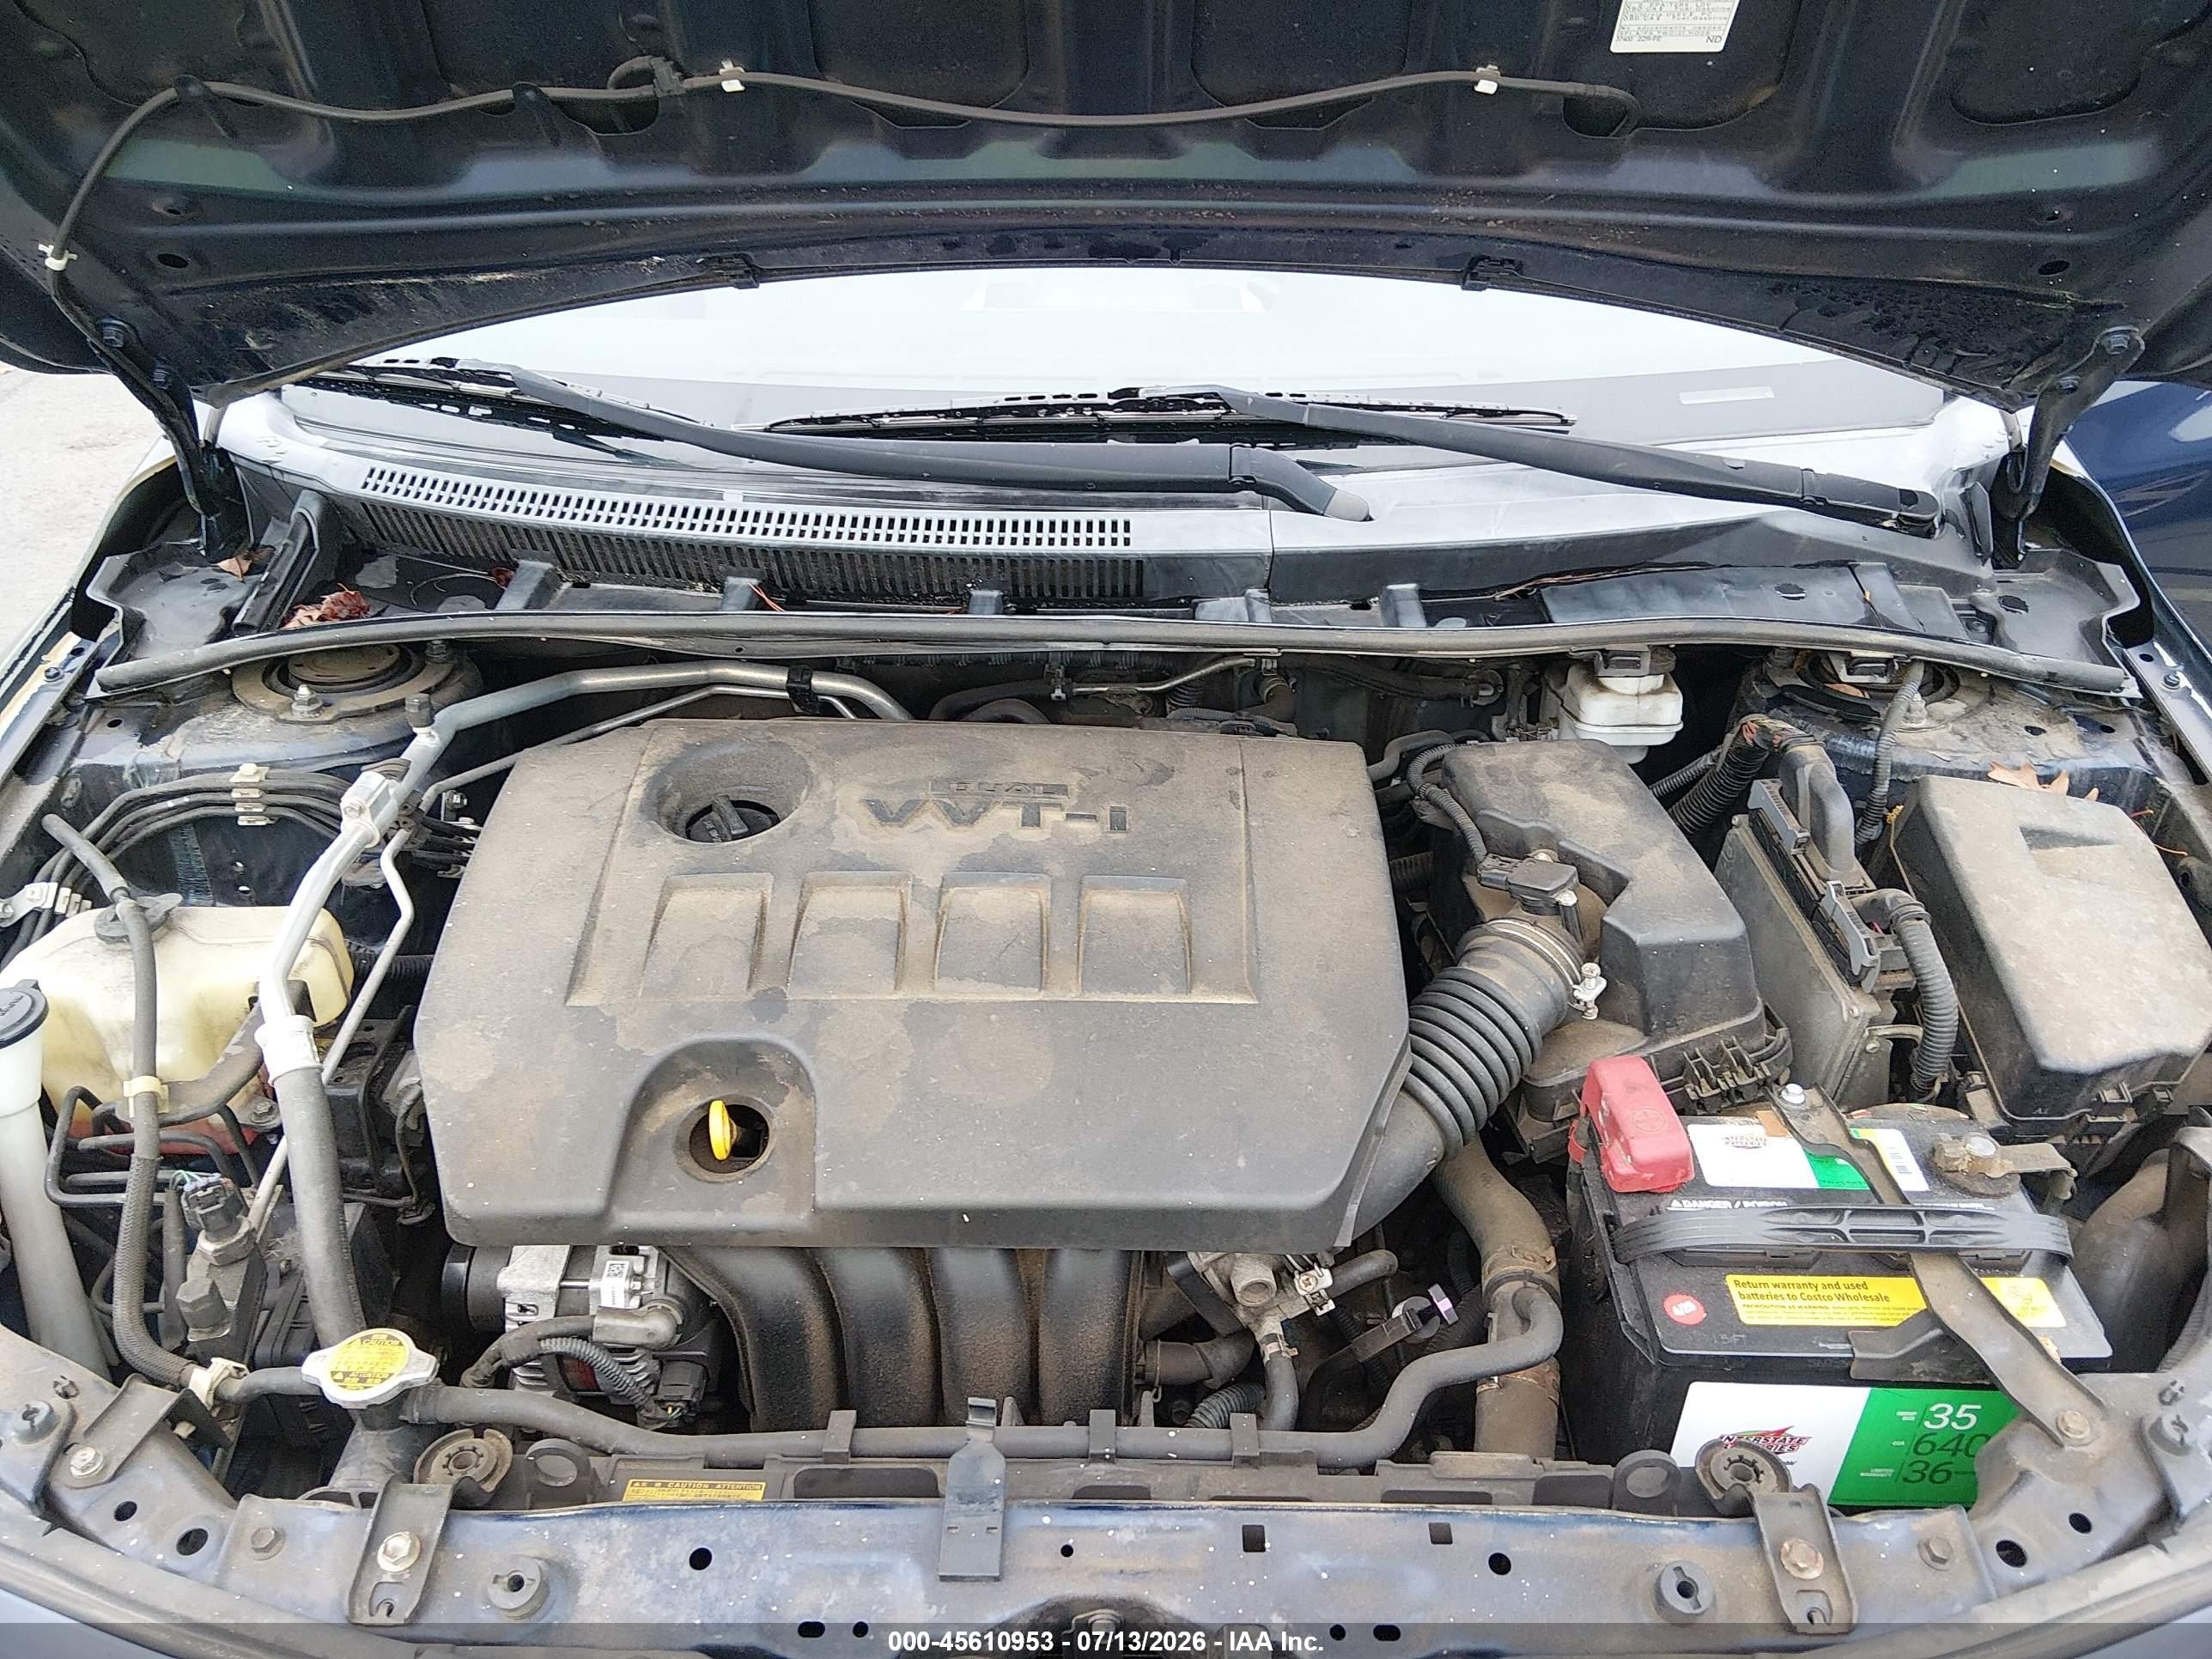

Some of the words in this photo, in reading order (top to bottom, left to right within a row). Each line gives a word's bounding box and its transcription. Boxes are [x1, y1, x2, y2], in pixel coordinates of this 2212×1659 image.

[1733, 1279, 1770, 1289] Return
[1772, 1281, 1818, 1291] warranty
[1821, 1281, 1841, 1290] and
[1844, 1281, 1869, 1290] used
[1738, 1291, 1785, 1300] batteries
[1800, 1292, 1833, 1302] Costco
[1834, 1292, 1890, 1302] Wholesale
[1923, 1403, 1983, 1431] 35
[1902, 1460, 1954, 1485] 36
